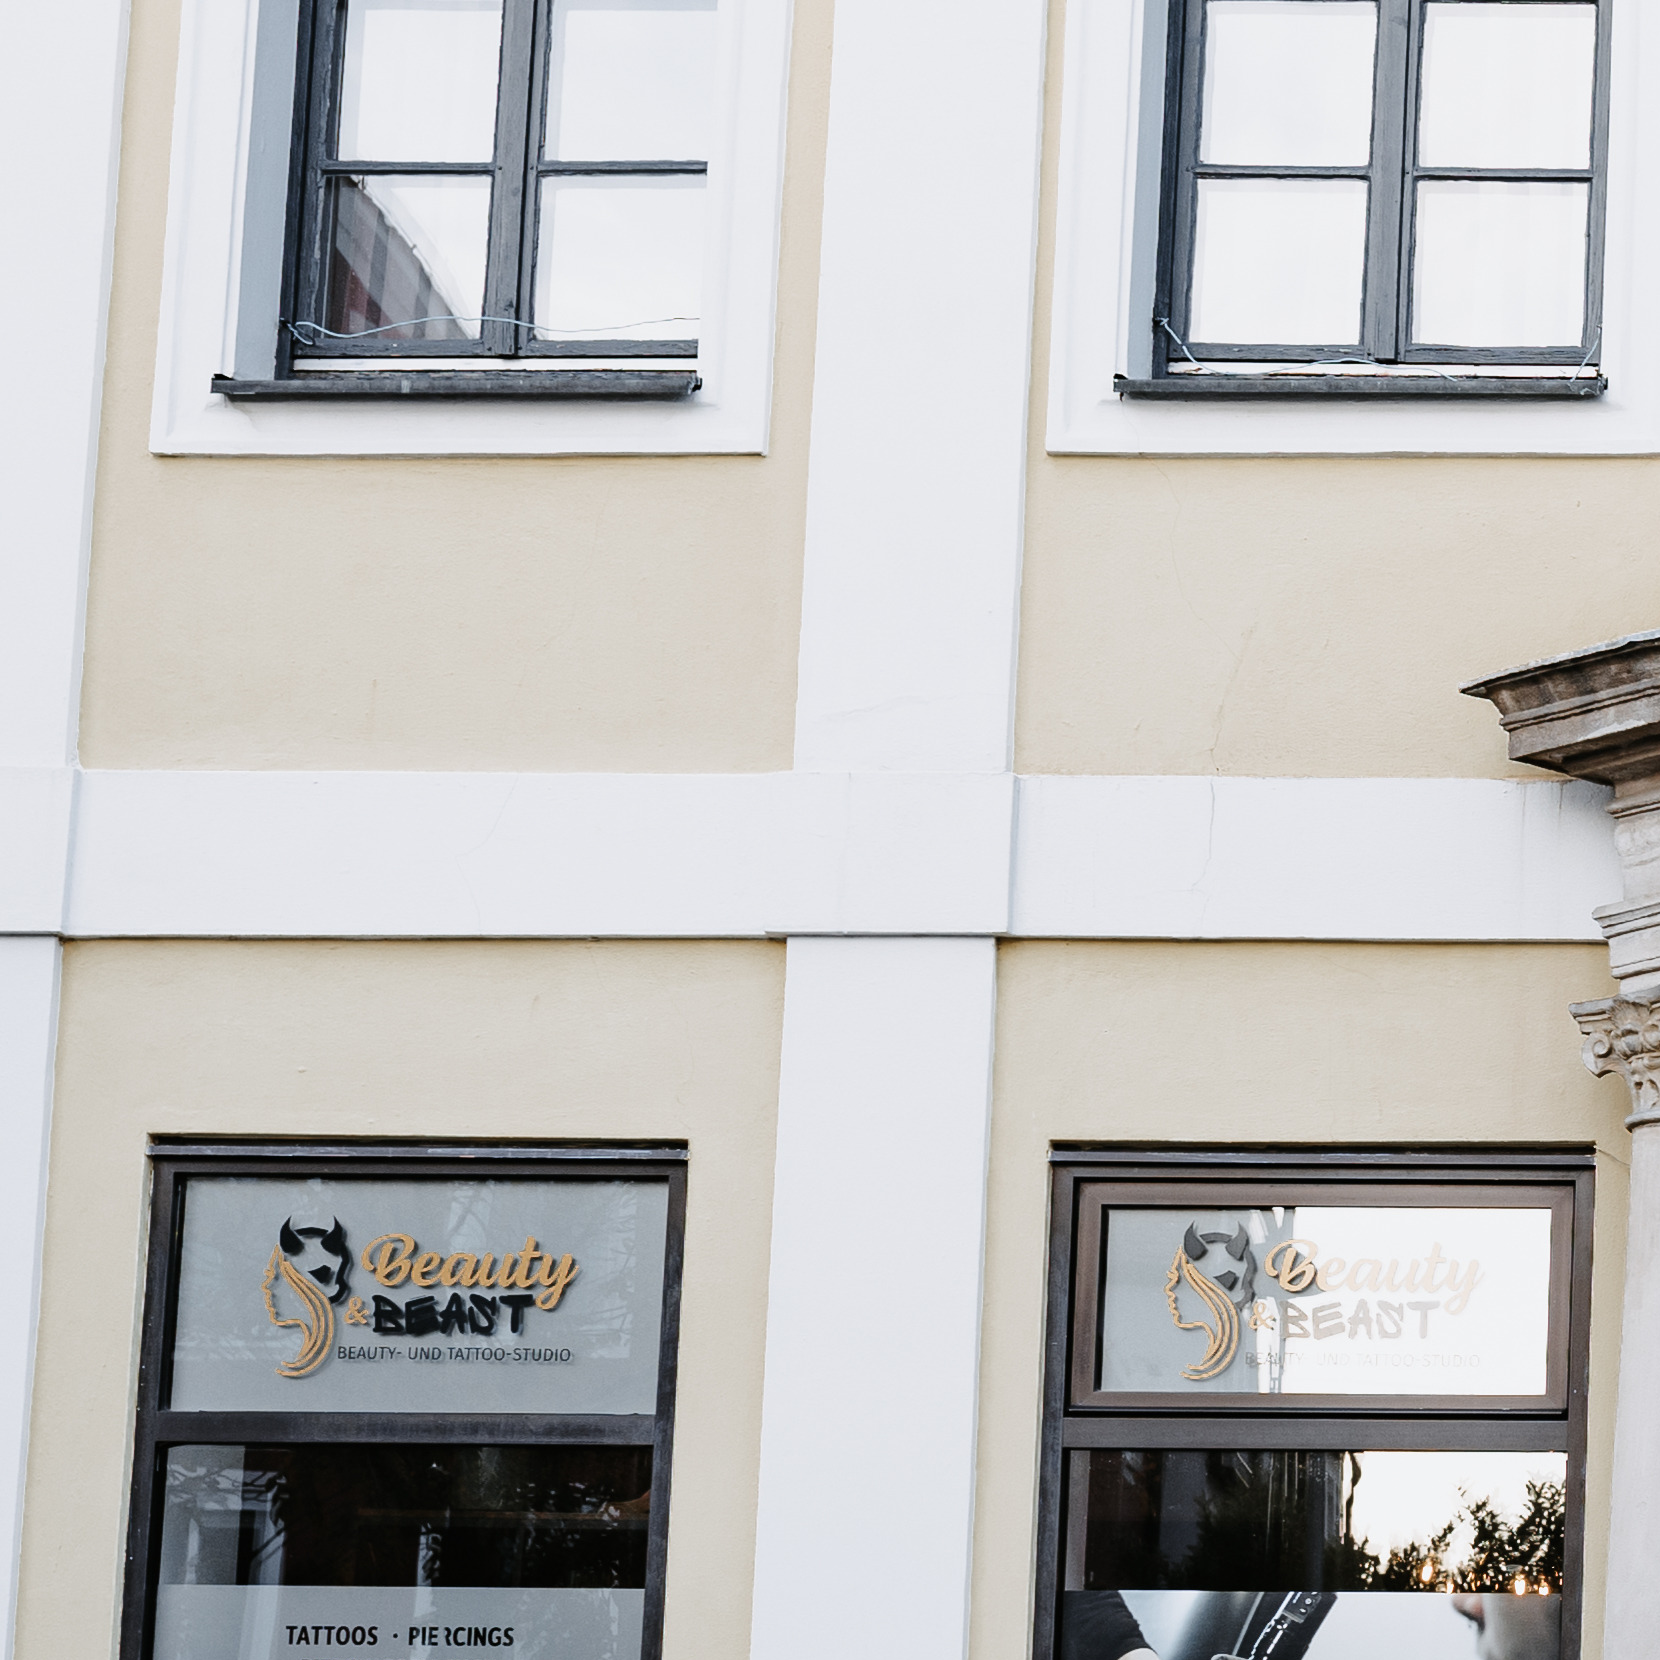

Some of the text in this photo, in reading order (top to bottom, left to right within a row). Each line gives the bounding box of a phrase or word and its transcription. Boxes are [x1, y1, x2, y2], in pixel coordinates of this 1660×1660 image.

[362, 1233, 580, 1310] Beauty
[1265, 1239, 1485, 1316] Beauty
[344, 1293, 536, 1335] & BEAST
[1247, 1299, 1442, 1341] & BEAST
[338, 1345, 572, 1363] BEAUTY- UND TATTOO-STUDIO
[285, 1625, 378, 1647] TATTOOS
